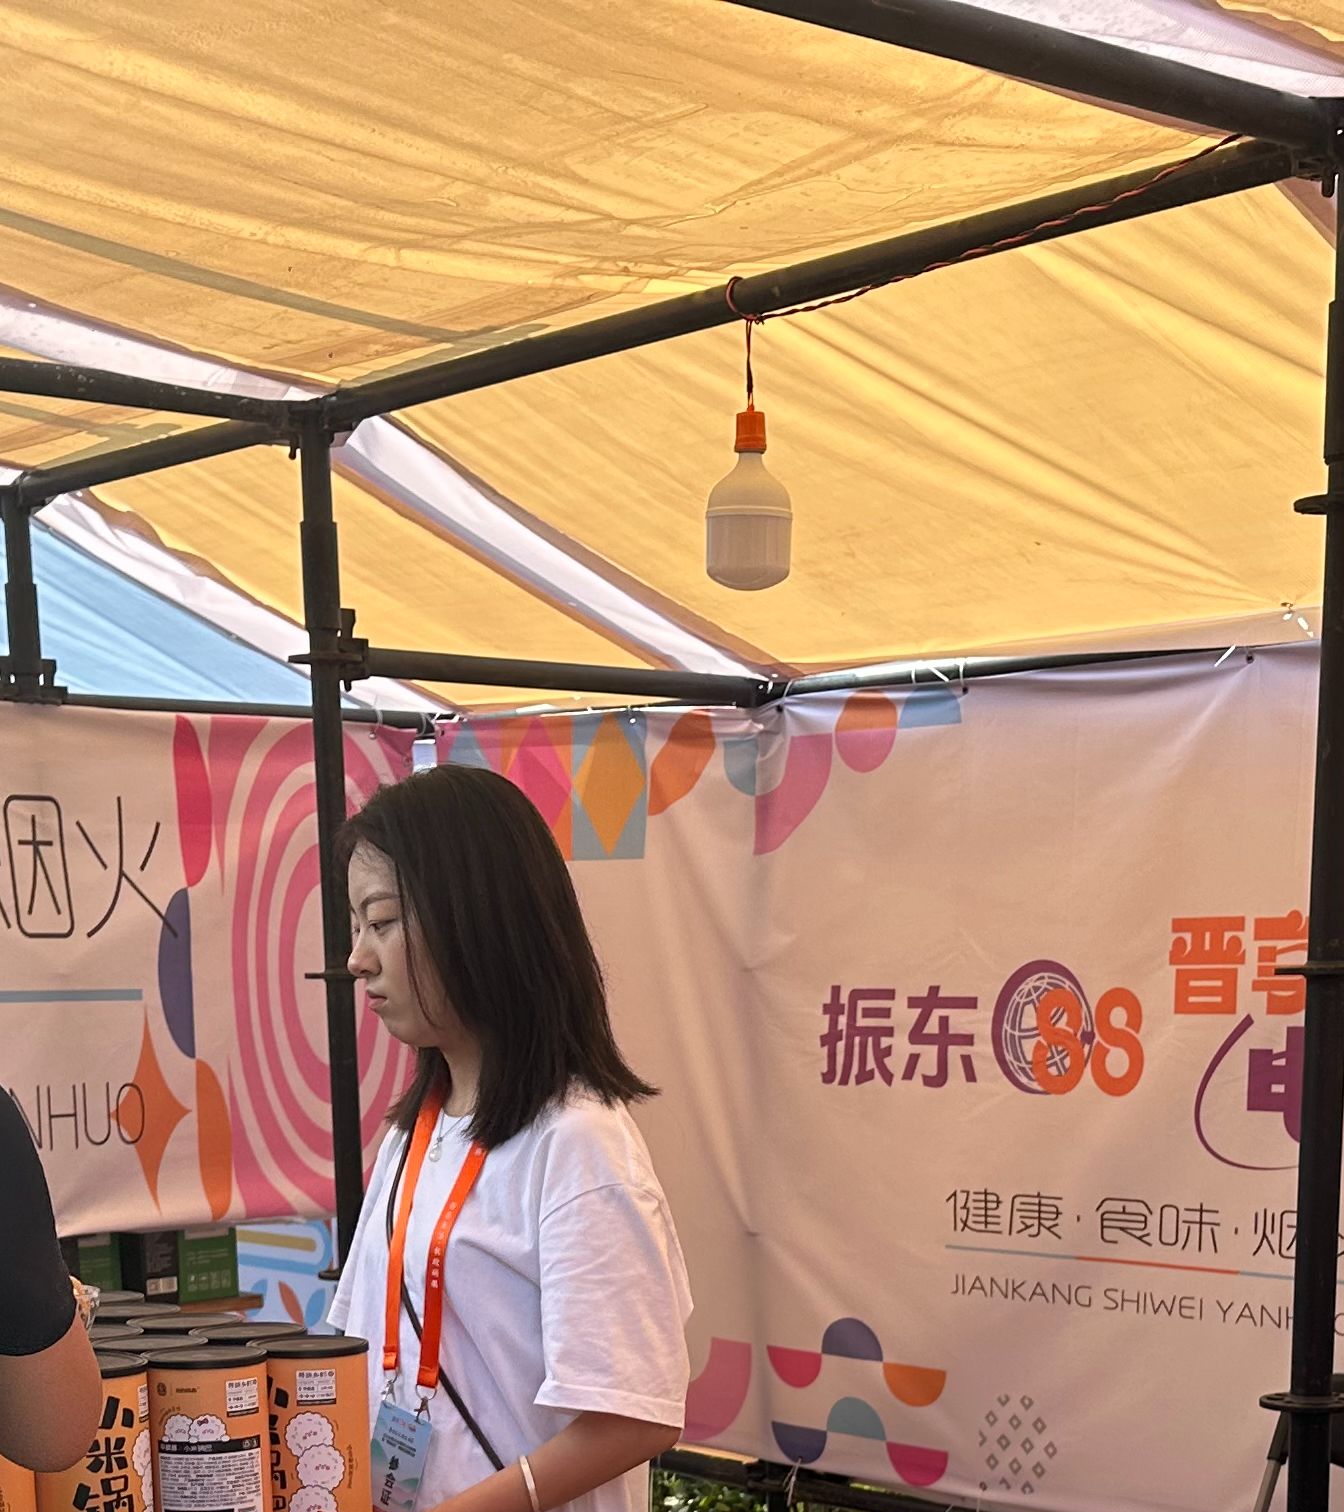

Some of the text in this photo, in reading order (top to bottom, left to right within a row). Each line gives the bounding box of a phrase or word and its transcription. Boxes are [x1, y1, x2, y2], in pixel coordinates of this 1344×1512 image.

[820, 985, 979, 1088] 振东
[29, 1083, 146, 1152] NHUO
[950, 1273, 1093, 1310] JIANKANG
[1103, 1287, 1204, 1321] SHIWEI
